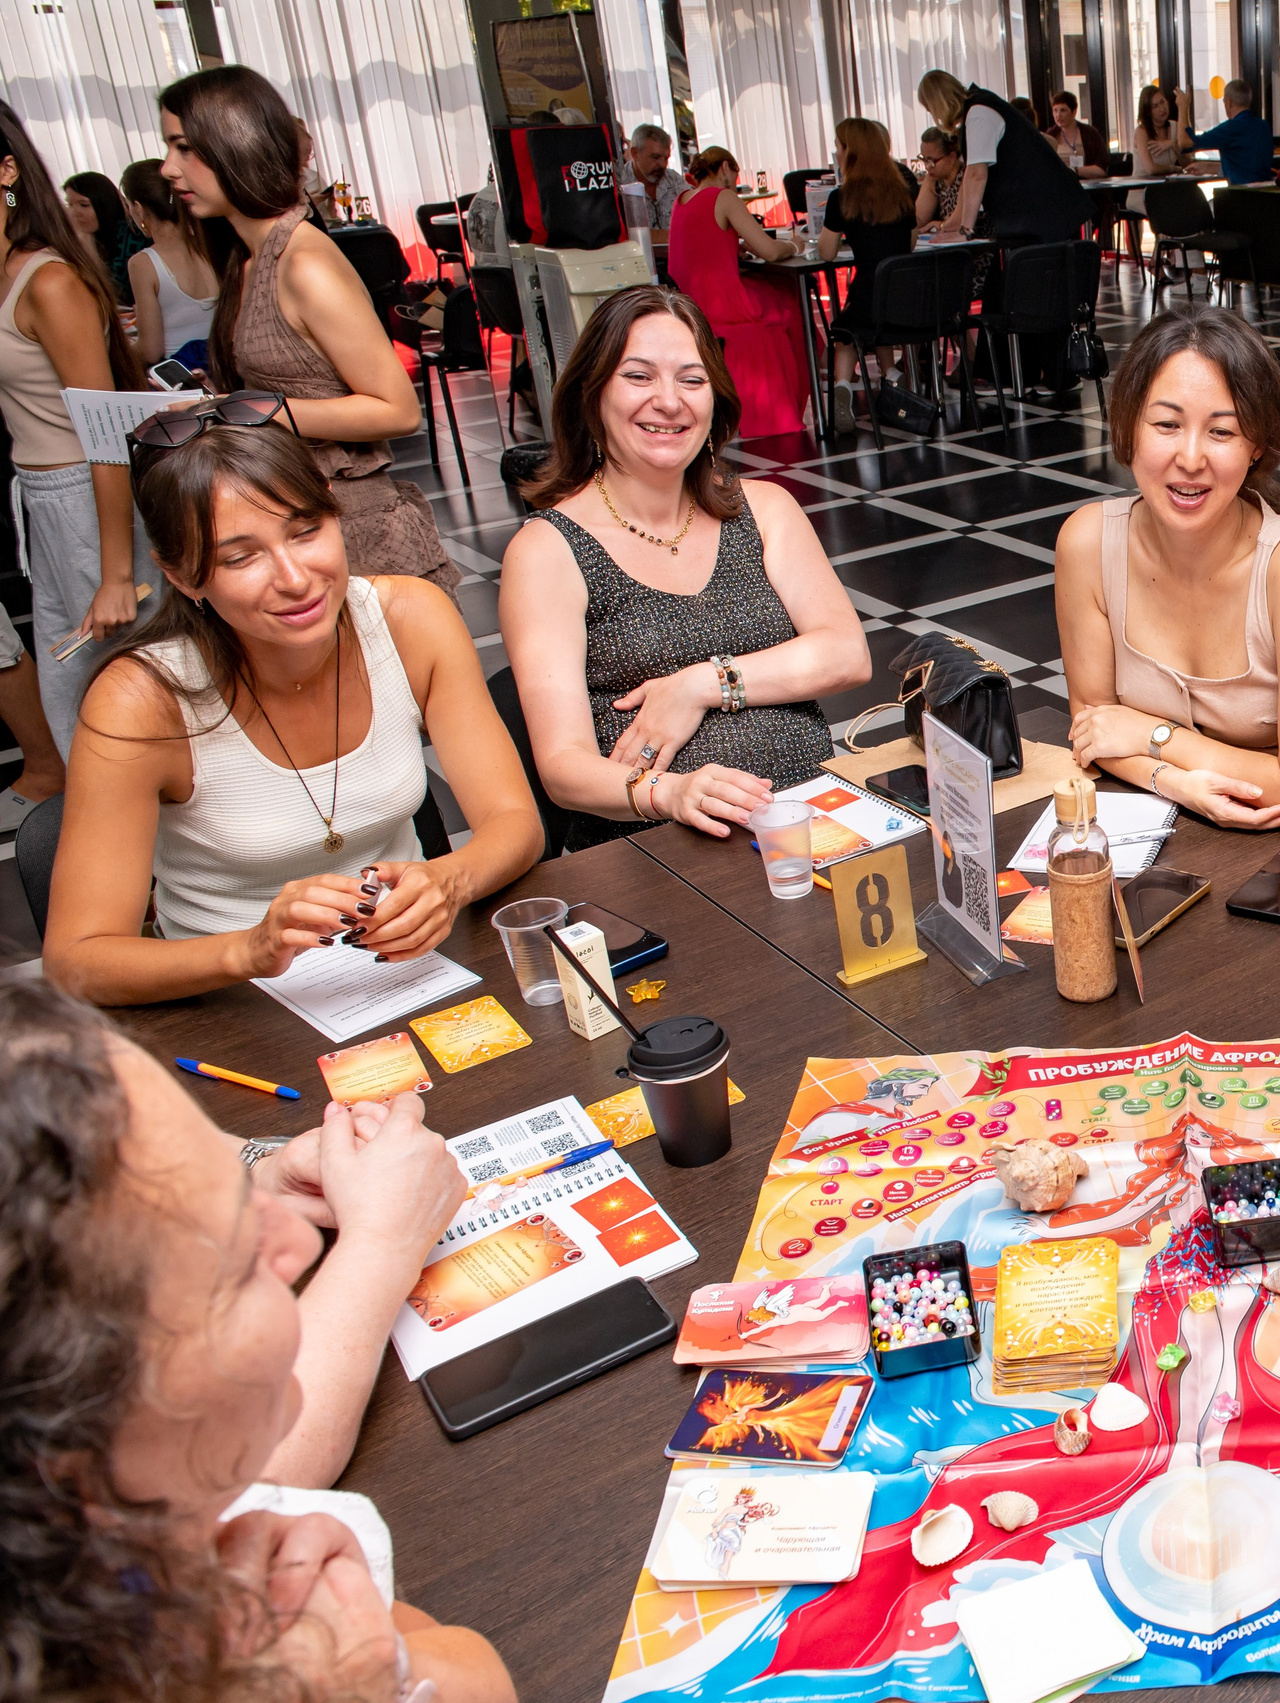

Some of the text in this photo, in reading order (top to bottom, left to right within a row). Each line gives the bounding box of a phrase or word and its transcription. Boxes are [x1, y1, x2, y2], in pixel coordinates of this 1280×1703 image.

[757, 173, 767, 188] 28
[356, 199, 371, 215] 26
[856, 873, 894, 949] 8
[1028, 1042, 1204, 1082] ПРОБУЖДЕНИЕ
[1140, 1068, 1162, 1076] Нить
[877, 1113, 938, 1136] Нить Любить
[801, 1134, 858, 1156] Бог Уран
[888, 1169, 998, 1221] Нить Испытывать страс
[810, 1198, 844, 1207] СТАРТ
[1023, 1276, 1082, 1286] возбуждаюсь,
[1030, 1281, 1086, 1292] возбуждение
[1037, 1290, 1080, 1298] нарастает
[693, 1300, 735, 1308] Послание
[1022, 1299, 1067, 1307] наполняет
[1068, 1294, 1102, 1302] каждую
[691, 1306, 734, 1315] Купидона
[1029, 1305, 1068, 1314] клеточку
[686, 1505, 718, 1514] Магия
[776, 1536, 826, 1544] Чарующая
[763, 1545, 841, 1554] очаровательная
[1134, 1622, 1185, 1648] Храм
